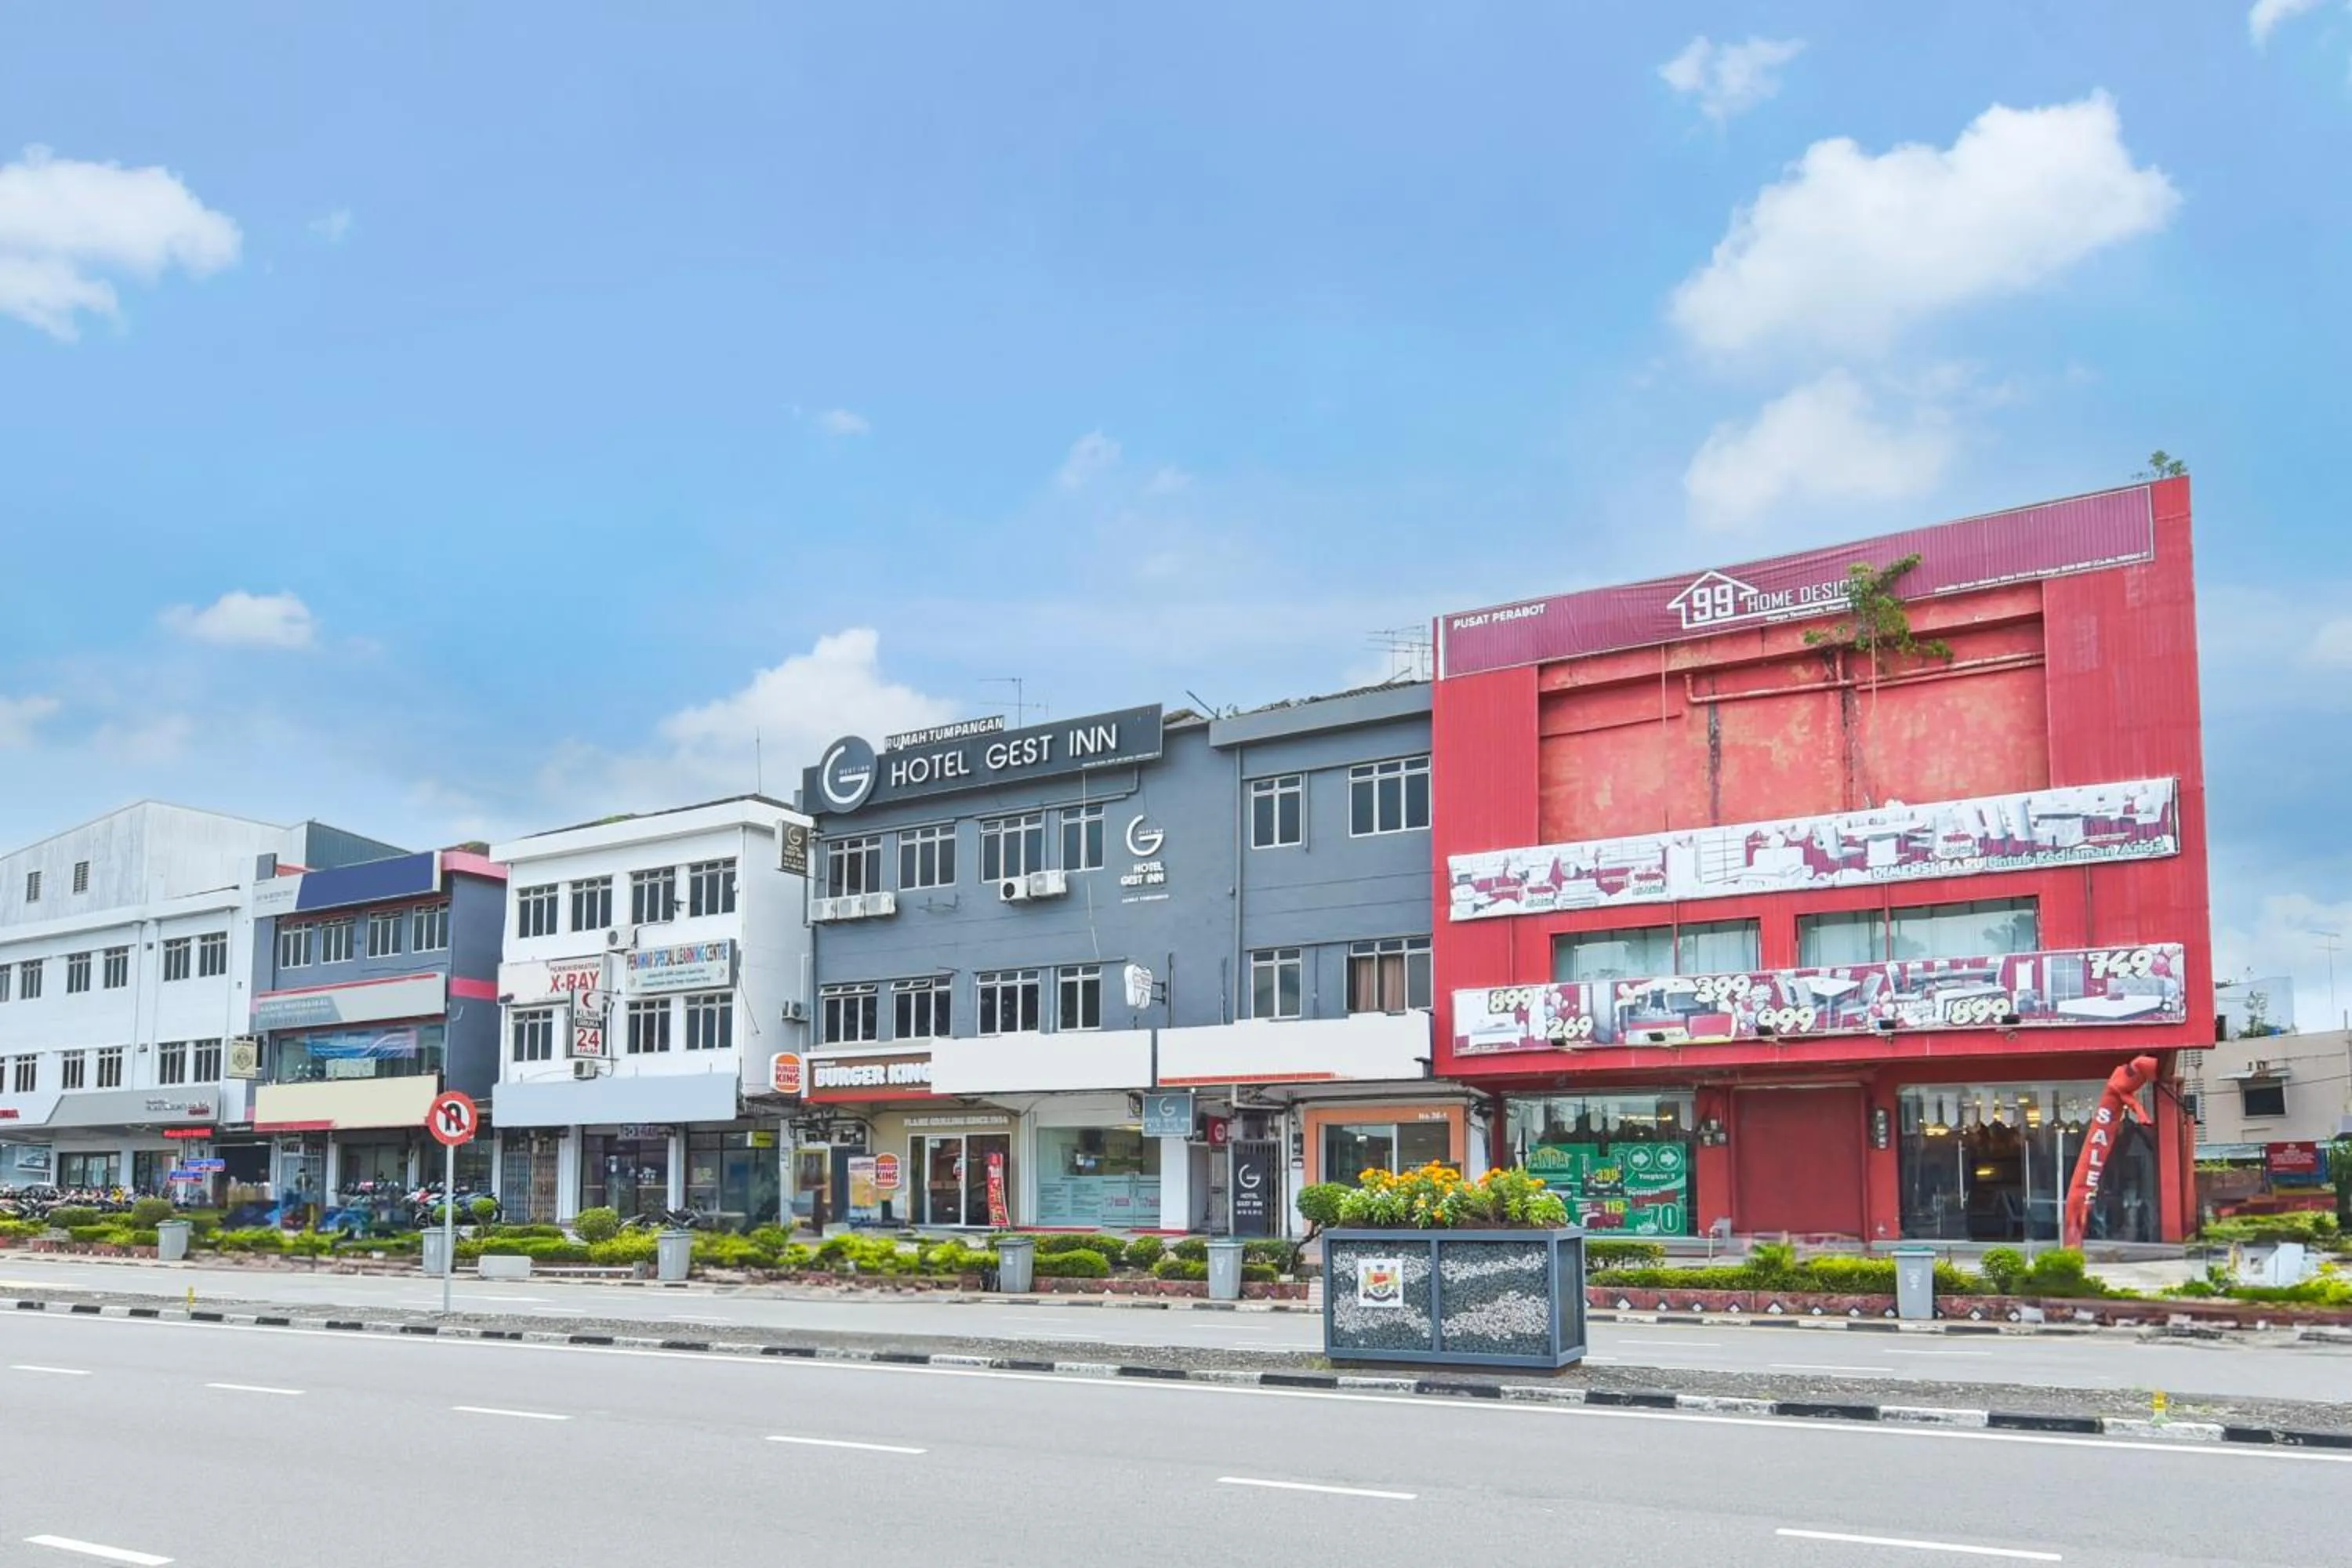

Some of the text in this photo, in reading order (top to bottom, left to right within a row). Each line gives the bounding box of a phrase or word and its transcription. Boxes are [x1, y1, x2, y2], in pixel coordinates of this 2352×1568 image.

[1693, 583, 1734, 622] 99
[1747, 589, 1795, 612] HOME
[1453, 603, 1547, 630] PUSAT PERABOT
[885, 717, 1004, 750] RUMAH TUMPANGAN
[891, 750, 970, 787] HOTEL
[985, 734, 1053, 770] GEST
[1069, 722, 1117, 757] INN
[1133, 861, 1164, 873] HOTEL
[1147, 872, 1165, 884] INN
[1872, 861, 1936, 880] DIMENSI
[1939, 856, 1986, 873] BARU
[2088, 949, 2154, 980] 749
[550, 971, 600, 993] X-RAY
[1693, 975, 1751, 1004] 399
[1489, 988, 1535, 1013] 899
[576, 1028, 600, 1048] 24
[1546, 1015, 1594, 1040] 269
[776, 1064, 800, 1073] BURGER
[776, 1073, 800, 1084] KING
[814, 1062, 932, 1087] BURGER KING
[877, 1171, 898, 1181] KING
